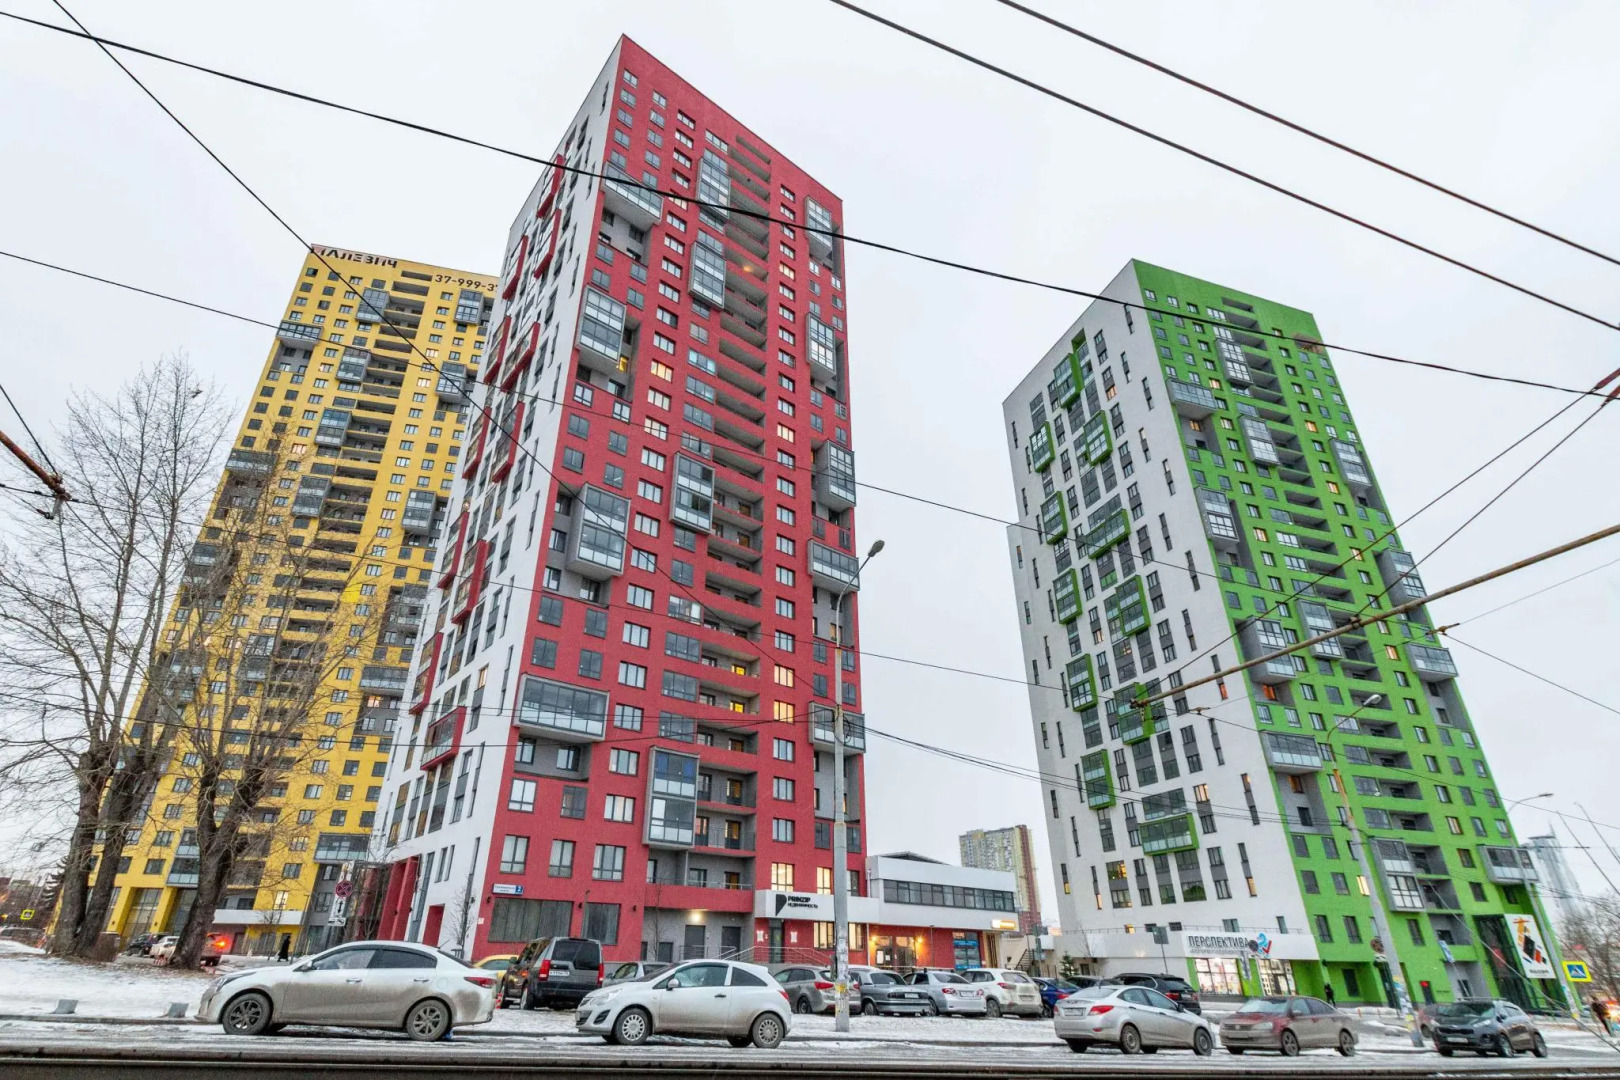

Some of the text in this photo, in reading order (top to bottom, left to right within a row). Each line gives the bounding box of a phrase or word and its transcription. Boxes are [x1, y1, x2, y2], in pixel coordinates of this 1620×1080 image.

[435, 274, 498, 292] 37-999-3
[788, 895, 811, 903] PRINZIP
[1188, 935, 1249, 950] ПЕРСПЕКТИВА
